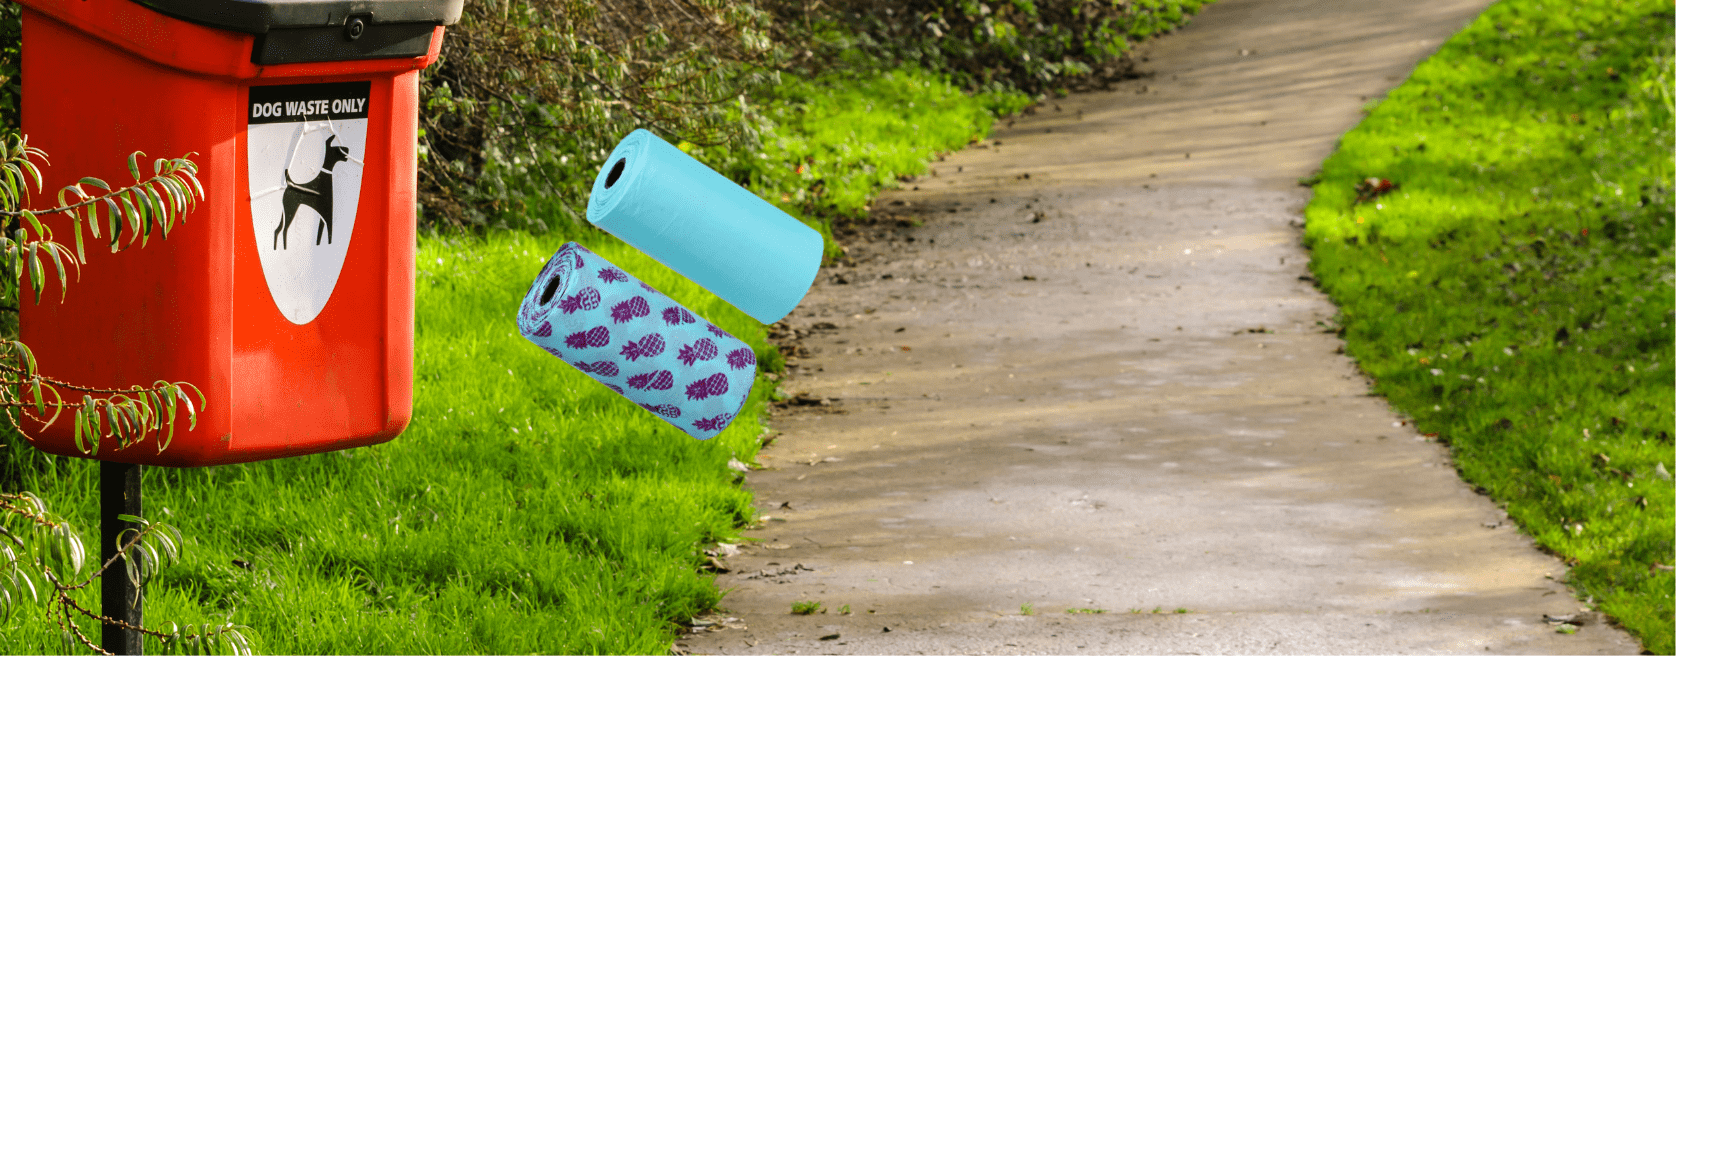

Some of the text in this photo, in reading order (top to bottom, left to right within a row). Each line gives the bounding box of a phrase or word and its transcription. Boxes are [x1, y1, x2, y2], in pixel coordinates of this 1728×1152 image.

[252, 98, 366, 118] DOG WASTE ONLY
